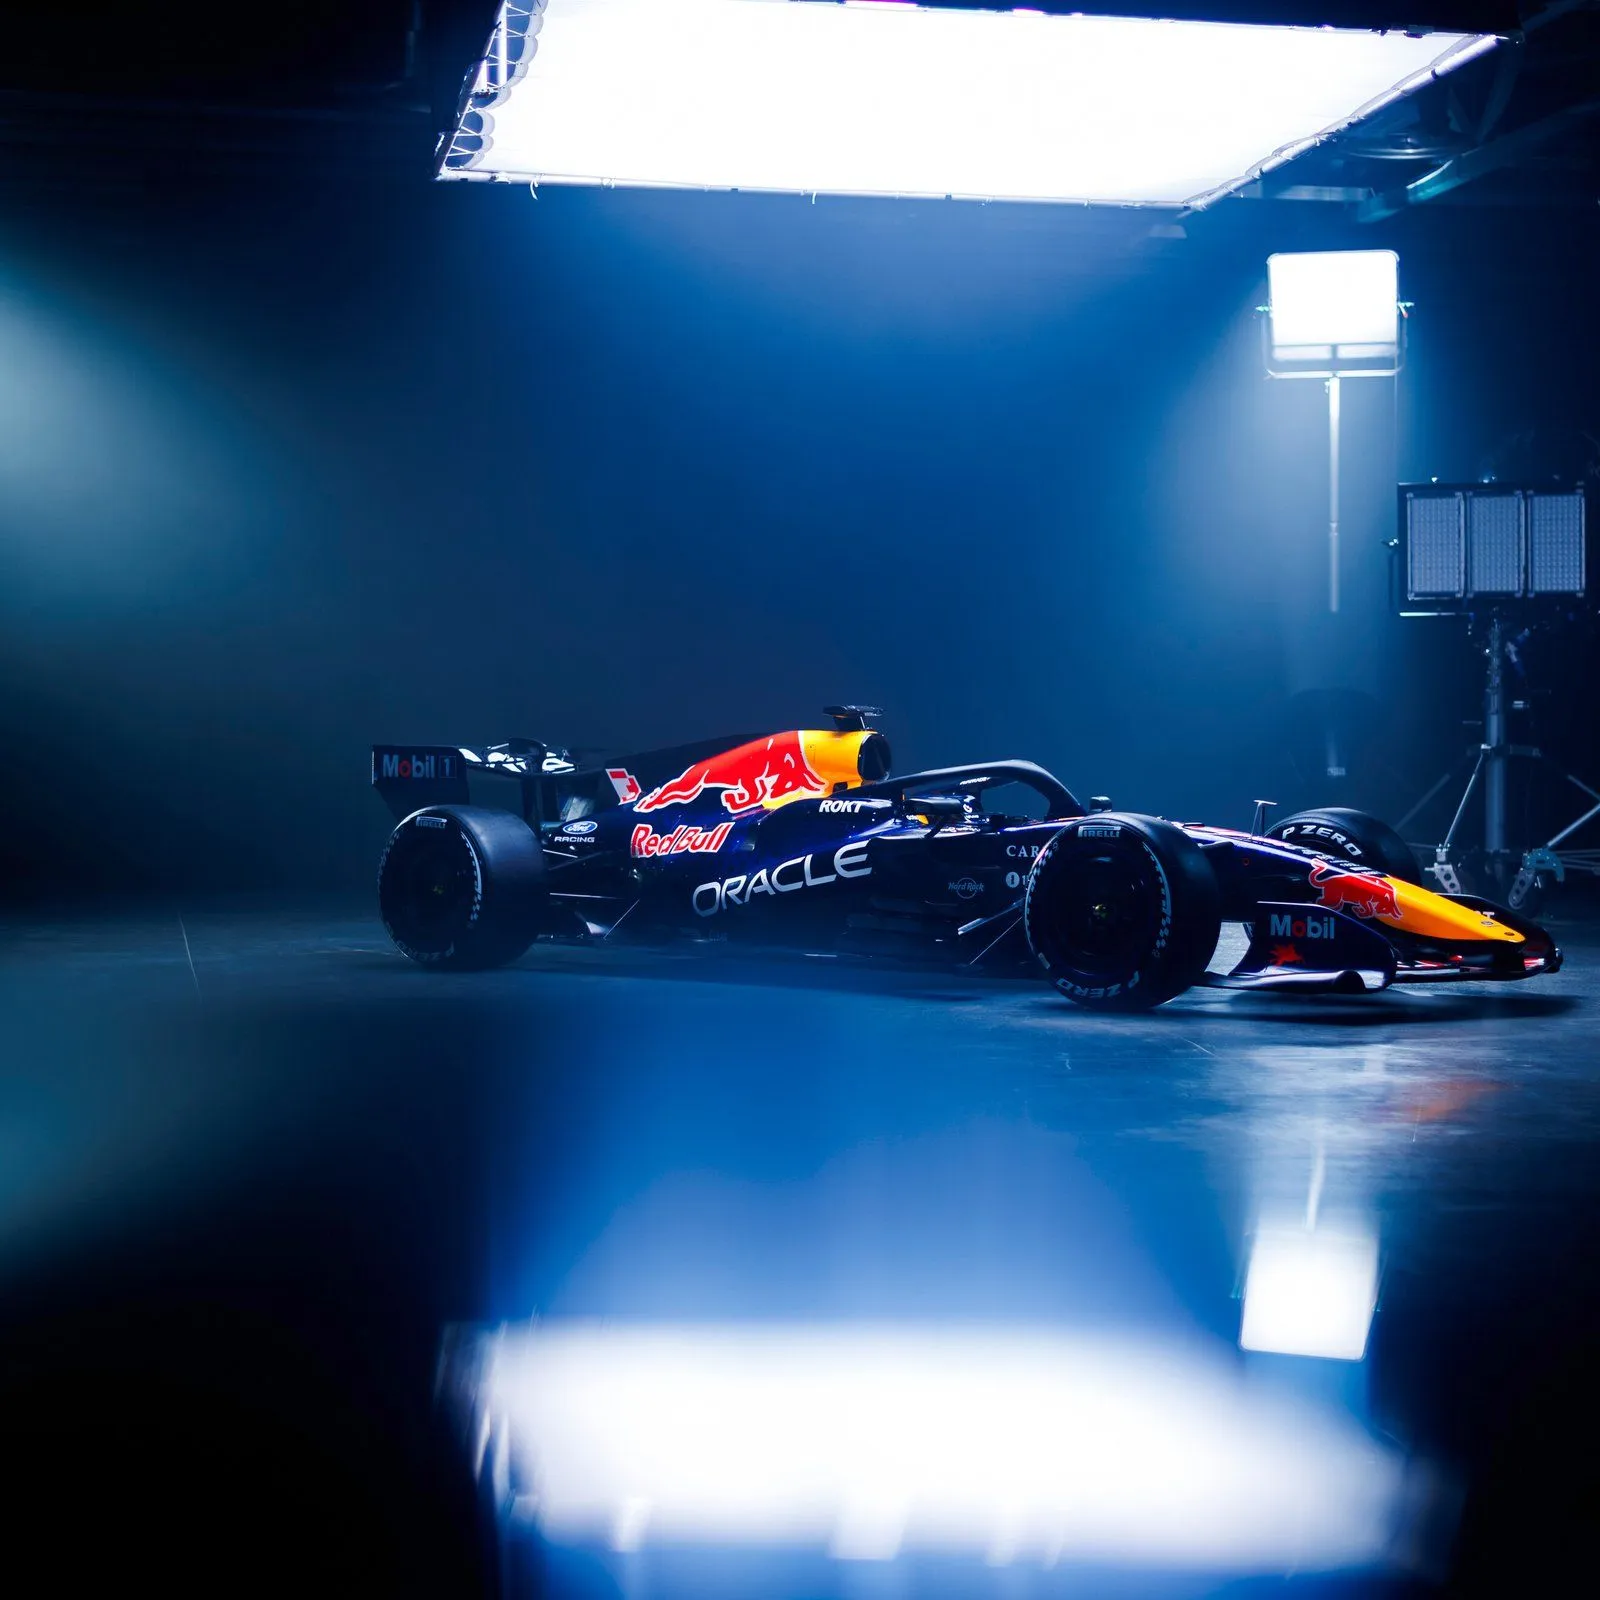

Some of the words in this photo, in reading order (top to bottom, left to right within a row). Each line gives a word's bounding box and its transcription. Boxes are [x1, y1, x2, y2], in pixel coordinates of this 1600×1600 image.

[382, 753, 435, 779] Mobil
[819, 799, 862, 813] ROKT
[1077, 825, 1121, 838] PIRELLI
[1282, 826, 1295, 840] P
[1300, 824, 1362, 856] ZERO
[692, 839, 872, 917] ORACLE
[1269, 913, 1336, 940] Mobil
[1056, 977, 1122, 999] ZERO
